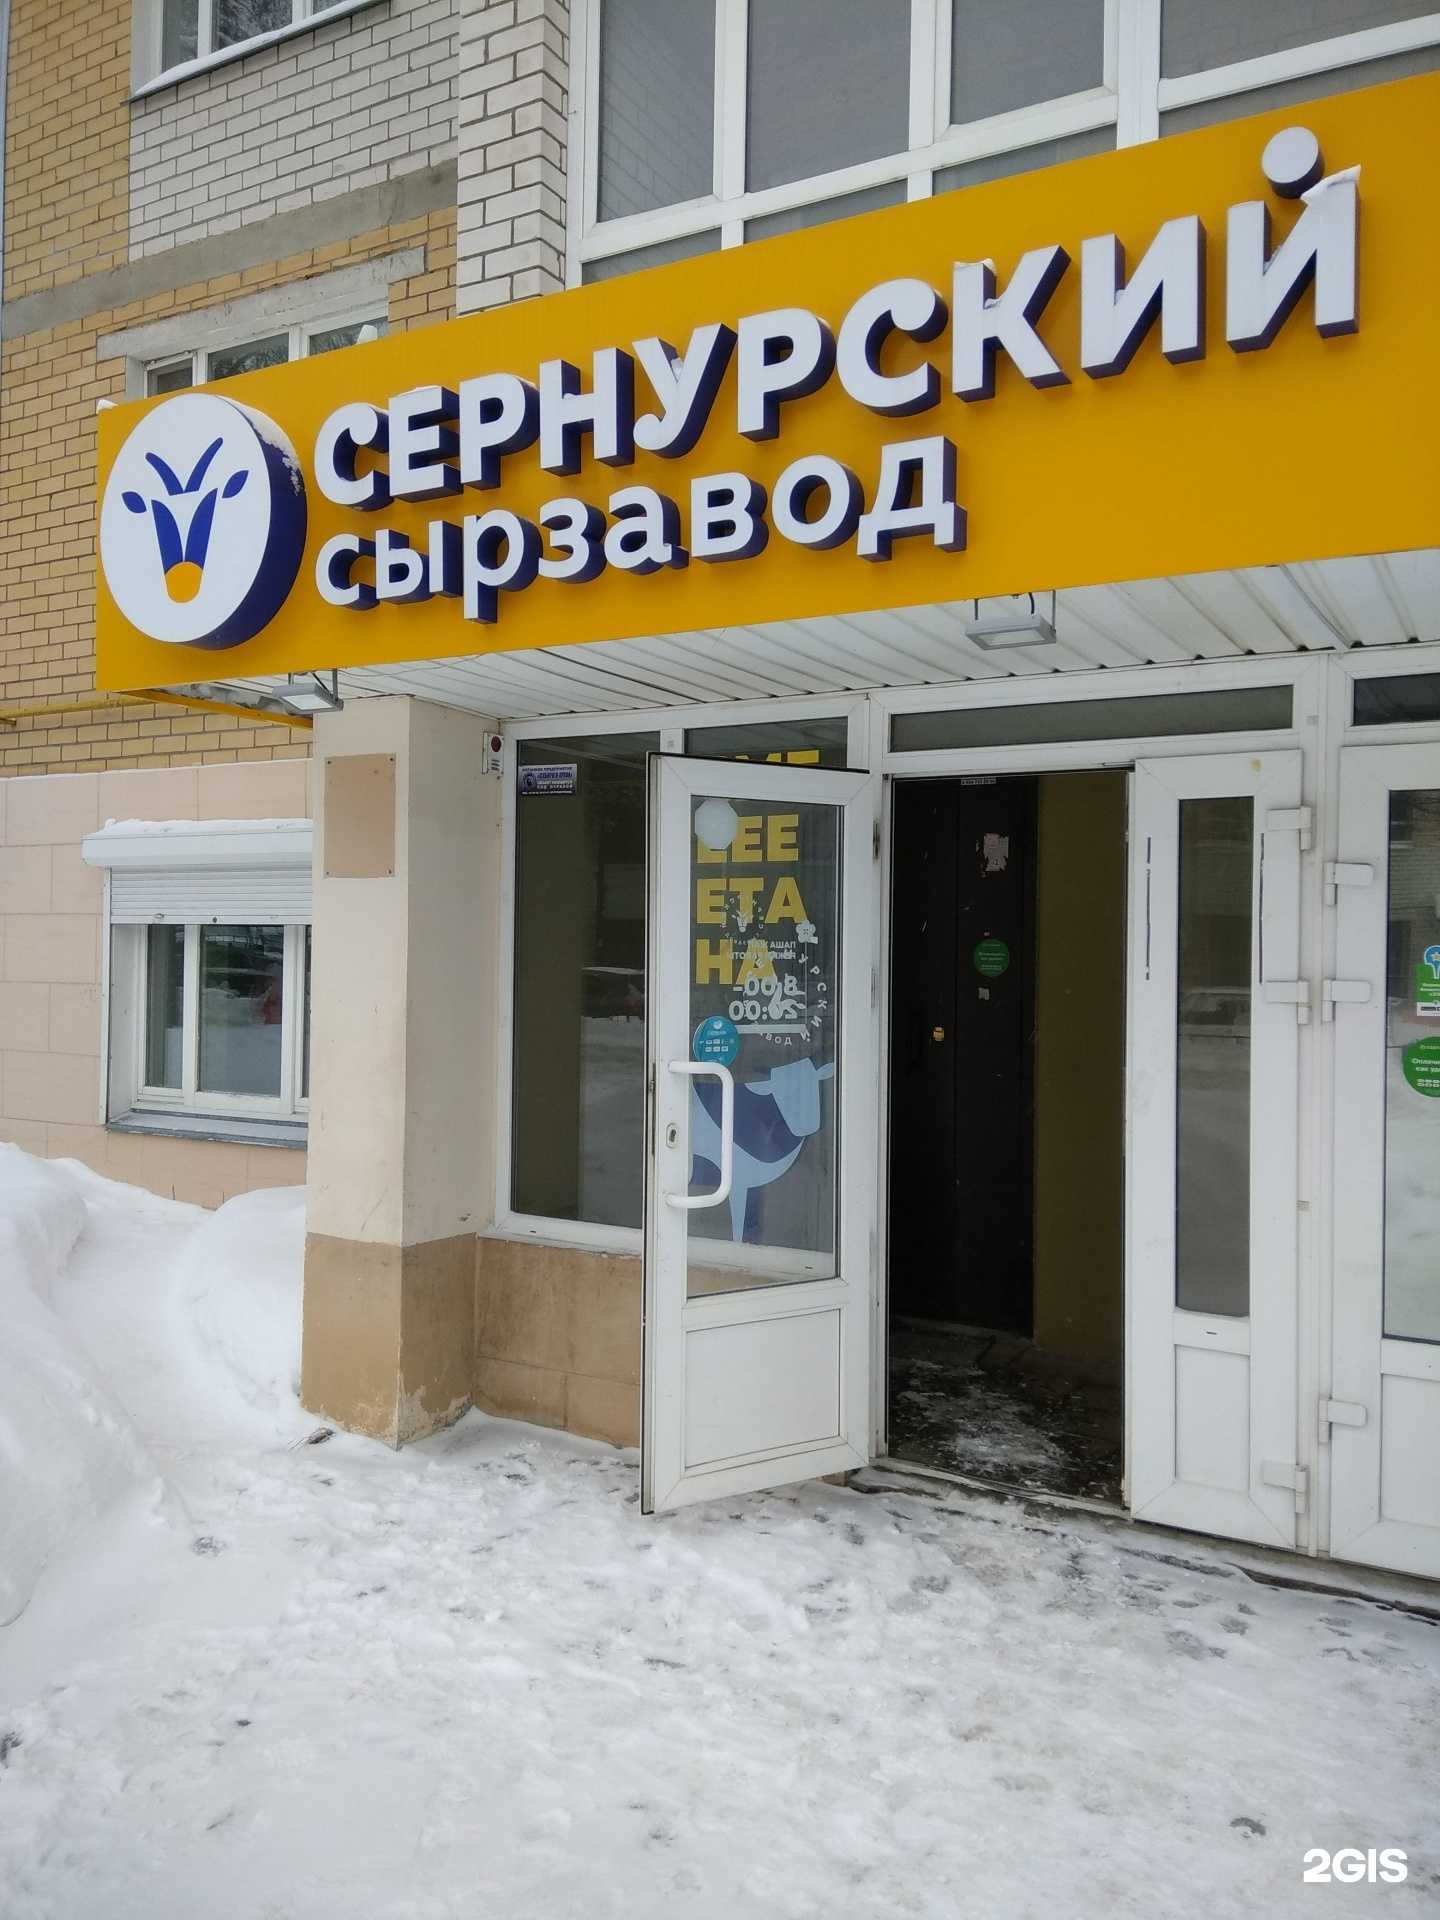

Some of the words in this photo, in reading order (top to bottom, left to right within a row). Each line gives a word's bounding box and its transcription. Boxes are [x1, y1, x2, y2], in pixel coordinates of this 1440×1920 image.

[313, 126, 1362, 512] СЕРНУРСКИЙ
[315, 435, 966, 623] сырзавод
[697, 877, 807, 924] ЕТА
[696, 939, 776, 985] НА
